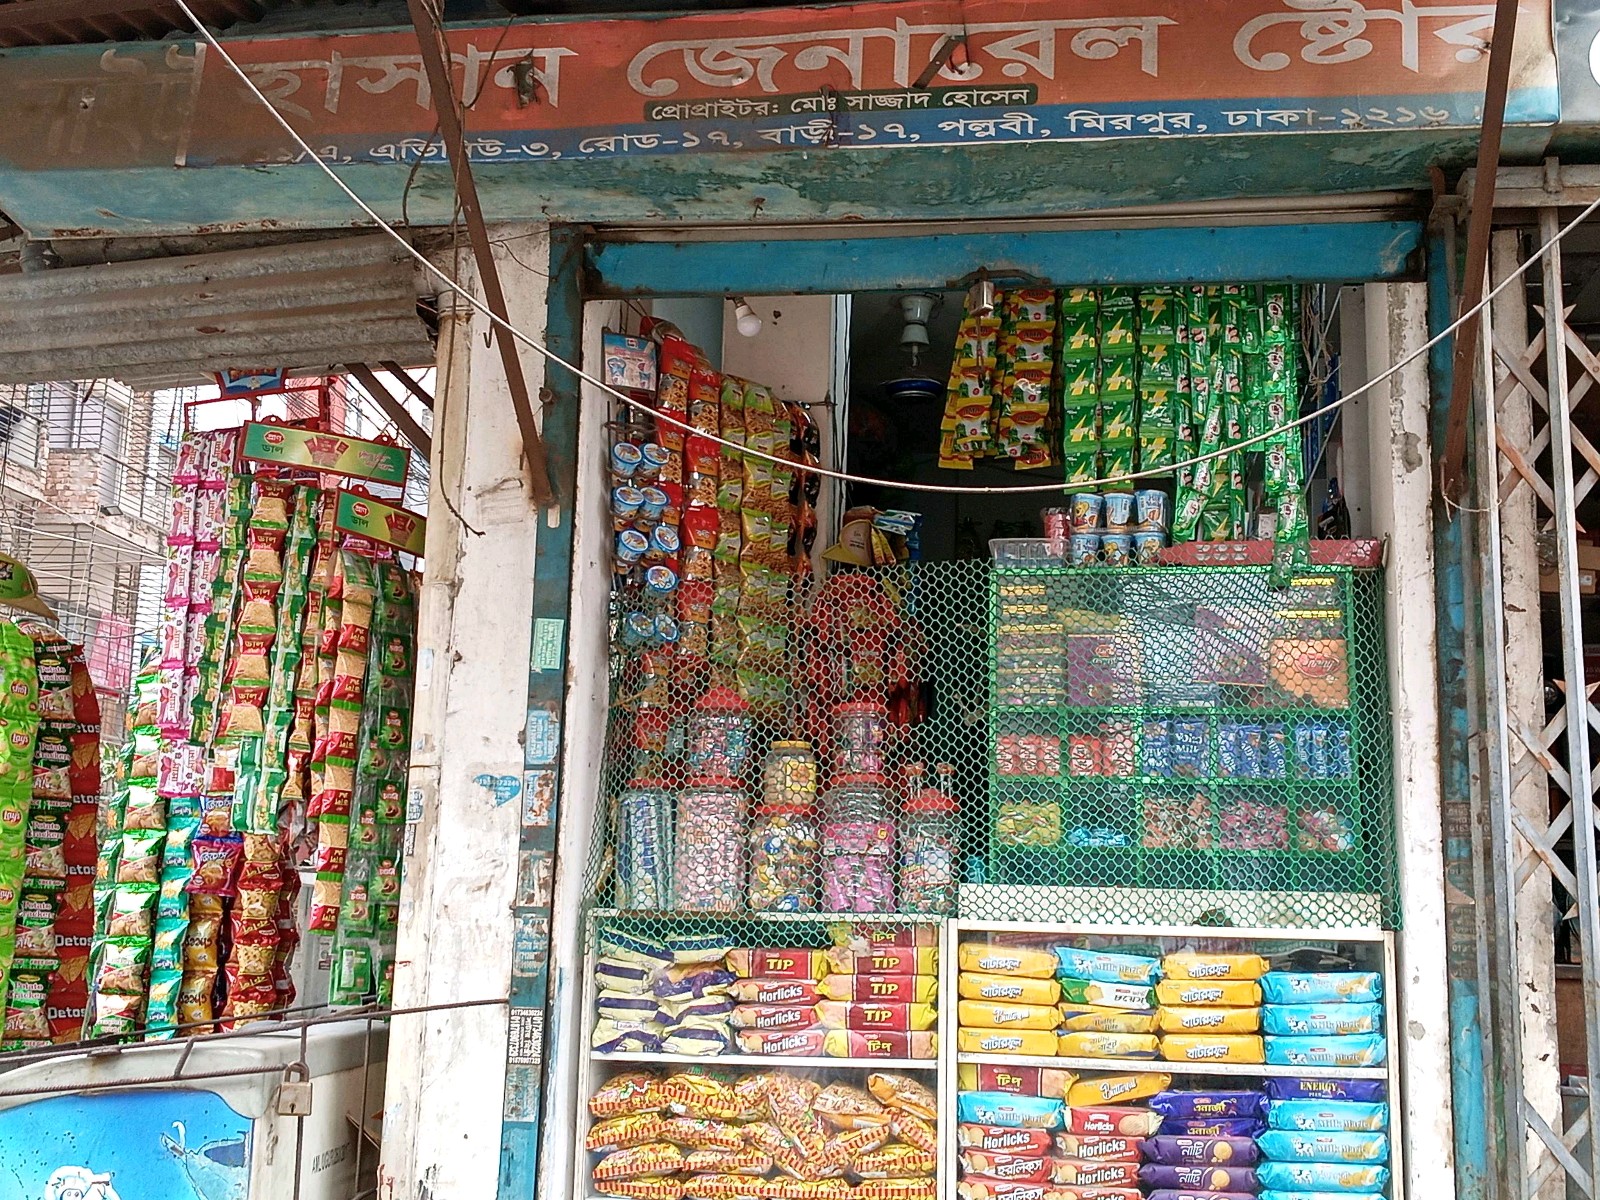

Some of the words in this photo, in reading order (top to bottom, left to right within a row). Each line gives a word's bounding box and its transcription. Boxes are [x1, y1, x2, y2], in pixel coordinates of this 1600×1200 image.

[225, 43, 578, 121] হাসান
[627, 16, 1178, 96] জেনারেল
[844, 91, 932, 110] সাজ্জাদ
[942, 89, 1030, 108] হোসেন
[1064, 109, 1207, 134] মিরপুর,
[75, 724, 100, 734] etos
[72, 794, 100, 804] etos
[54, 934, 93, 947] Detos
[766, 958, 795, 971] TIP
[871, 957, 901, 969] TIP
[758, 985, 803, 1003] Horlicks
[870, 983, 899, 995] TIP
[47, 1006, 86, 1020] Detos
[756, 1010, 801, 1028] Horlicks
[863, 1010, 893, 1022] TIP
[763, 1035, 808, 1054] Horlicks
[1299, 1081, 1338, 1092] ENERGY
[1082, 1120, 1115, 1132] Horlicks
[983, 1131, 1031, 1150] Horlicks
[1078, 1138, 1126, 1158] Horlicks
[1077, 1166, 1125, 1186] Horlicks
